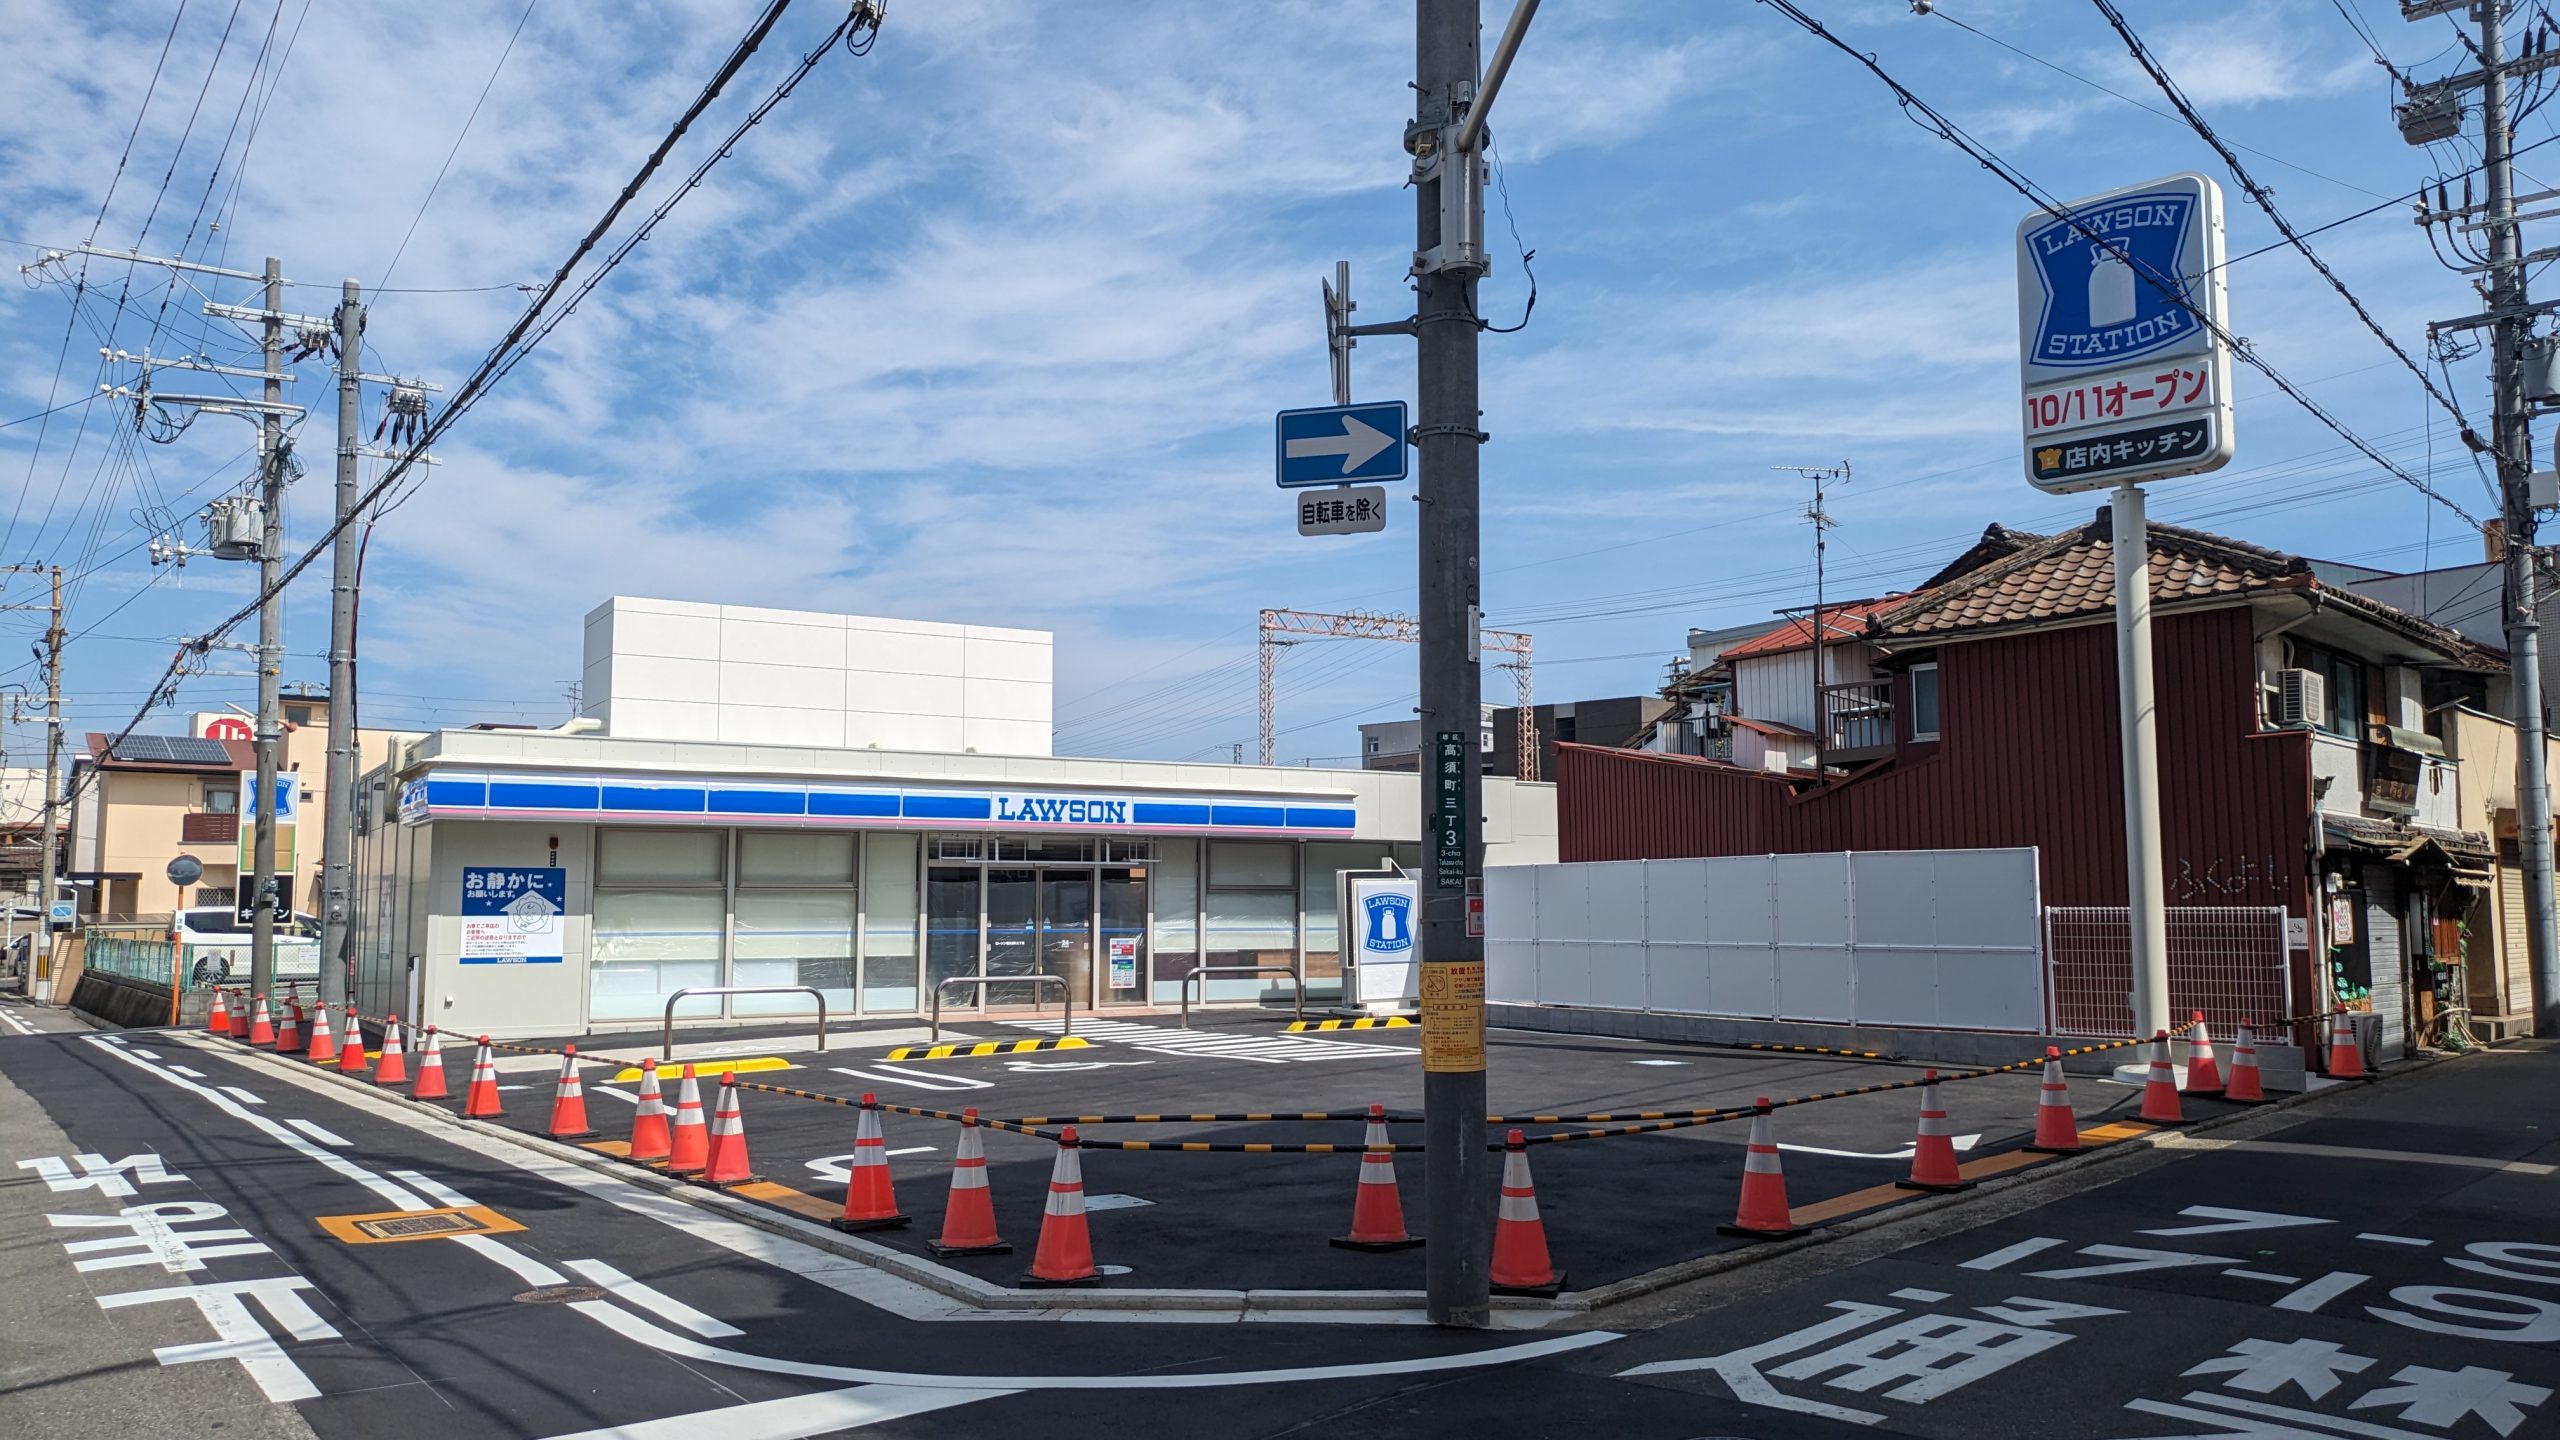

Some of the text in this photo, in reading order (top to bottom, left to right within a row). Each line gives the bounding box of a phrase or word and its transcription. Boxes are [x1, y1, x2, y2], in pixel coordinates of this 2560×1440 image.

[2042, 204, 2179, 255] LAWSON
[2048, 309, 2181, 355] STATION
[2027, 368, 2207, 429] 10/11オープン
[2065, 428, 2204, 470] 店内キッチン
[1302, 497, 1381, 525] 自転車を除く
[997, 796, 1127, 824] LAWSON
[1441, 849, 1461, 857] 3-cho
[1438, 858, 1464, 866] Takasu-cho
[1438, 867, 1464, 875] Sakai-ku
[466, 872, 544, 889] お静かに
[1440, 878, 1462, 886] SAKAI
[467, 890, 516, 899] お願いします。
[1367, 896, 1408, 909] LAWSON
[240, 908, 290, 920] キン
[1369, 937, 1409, 950] STATION
